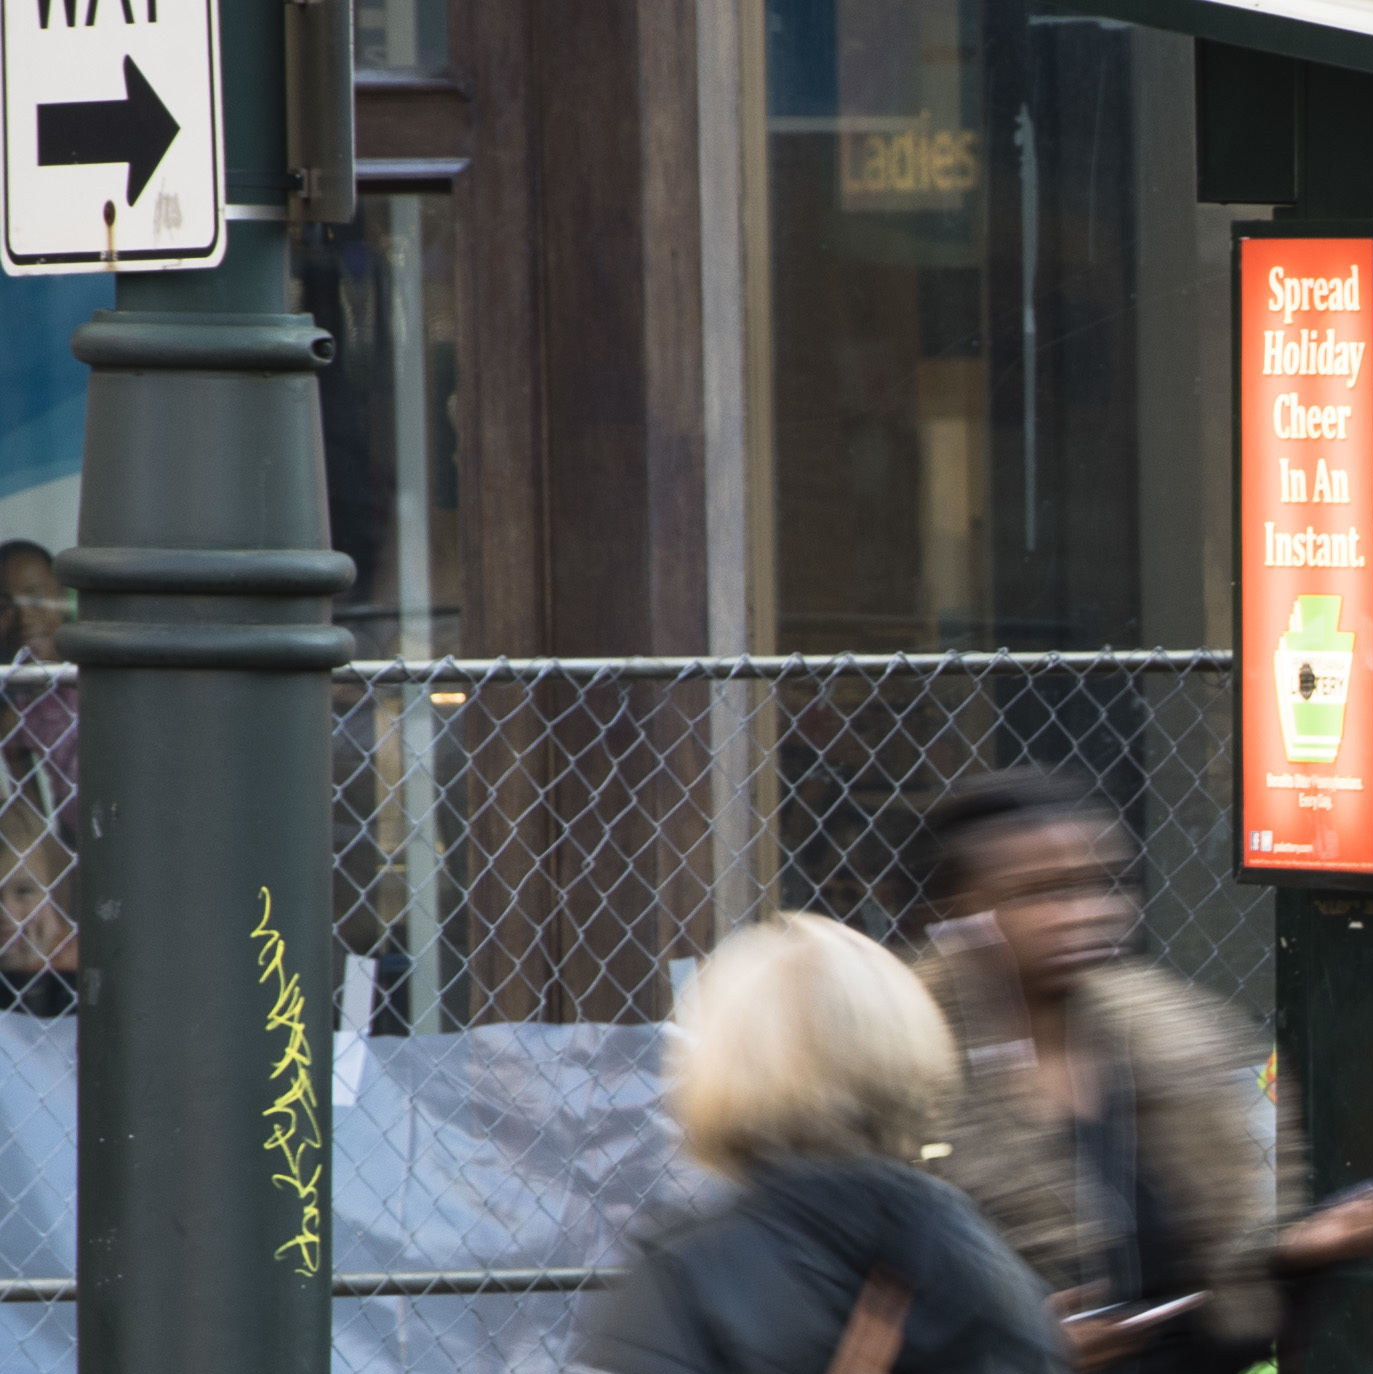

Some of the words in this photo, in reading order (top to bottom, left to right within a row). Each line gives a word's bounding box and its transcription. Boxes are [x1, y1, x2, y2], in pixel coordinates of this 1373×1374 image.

[1268, 265, 1360, 324] Spread
[1262, 328, 1365, 387] Holiday
[1273, 392, 1351, 440] Cheer
[1279, 457, 1308, 503] In
[1312, 457, 1350, 503] An
[1264, 521, 1366, 568] Instant.
